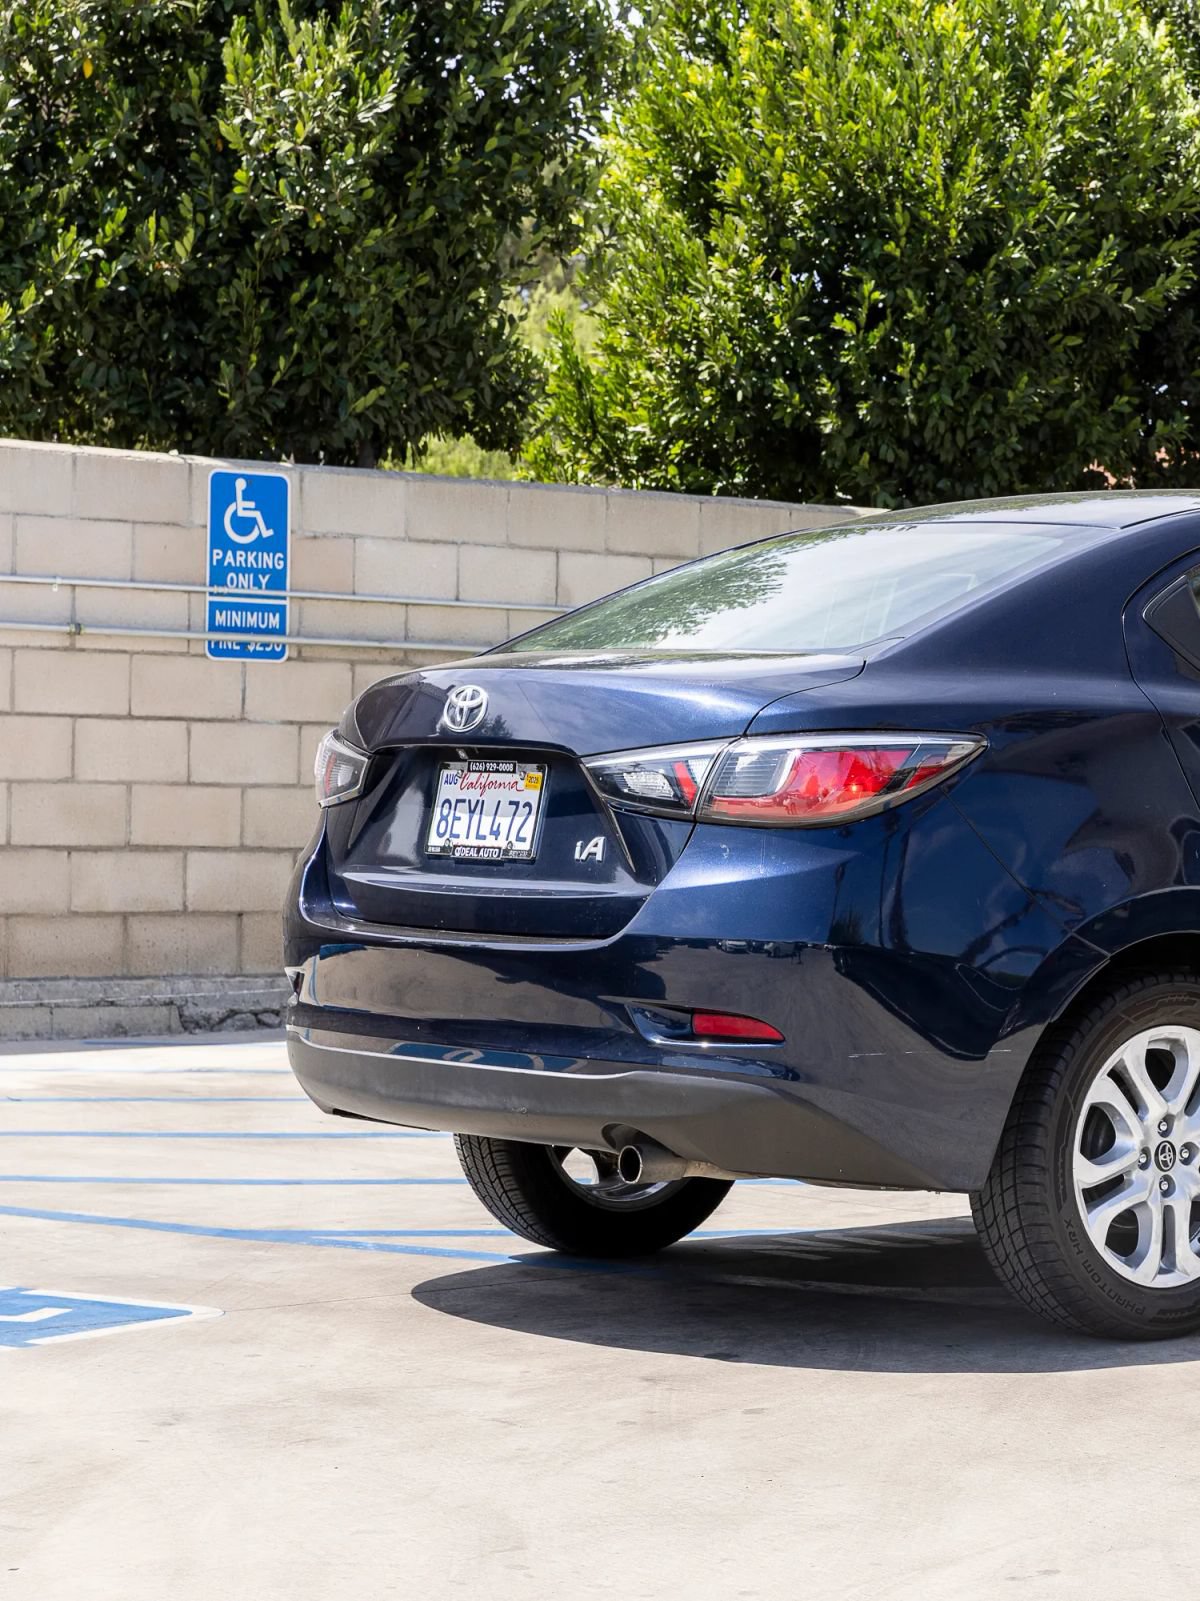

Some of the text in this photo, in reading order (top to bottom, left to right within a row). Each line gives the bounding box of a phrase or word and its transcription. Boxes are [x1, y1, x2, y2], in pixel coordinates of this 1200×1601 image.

[213, 549, 285, 570] PARKING
[227, 572, 271, 590] ONLY
[215, 609, 280, 629] MINIMUM
[470, 762, 485, 772] (626)
[443, 773, 458, 786] AUG
[460, 772, 524, 797] California
[436, 798, 533, 843] 8EYL472
[479, 848, 499, 858] AUTO
[574, 836, 607, 863] iA
[1082, 1259, 1147, 1316] PHANTOM
